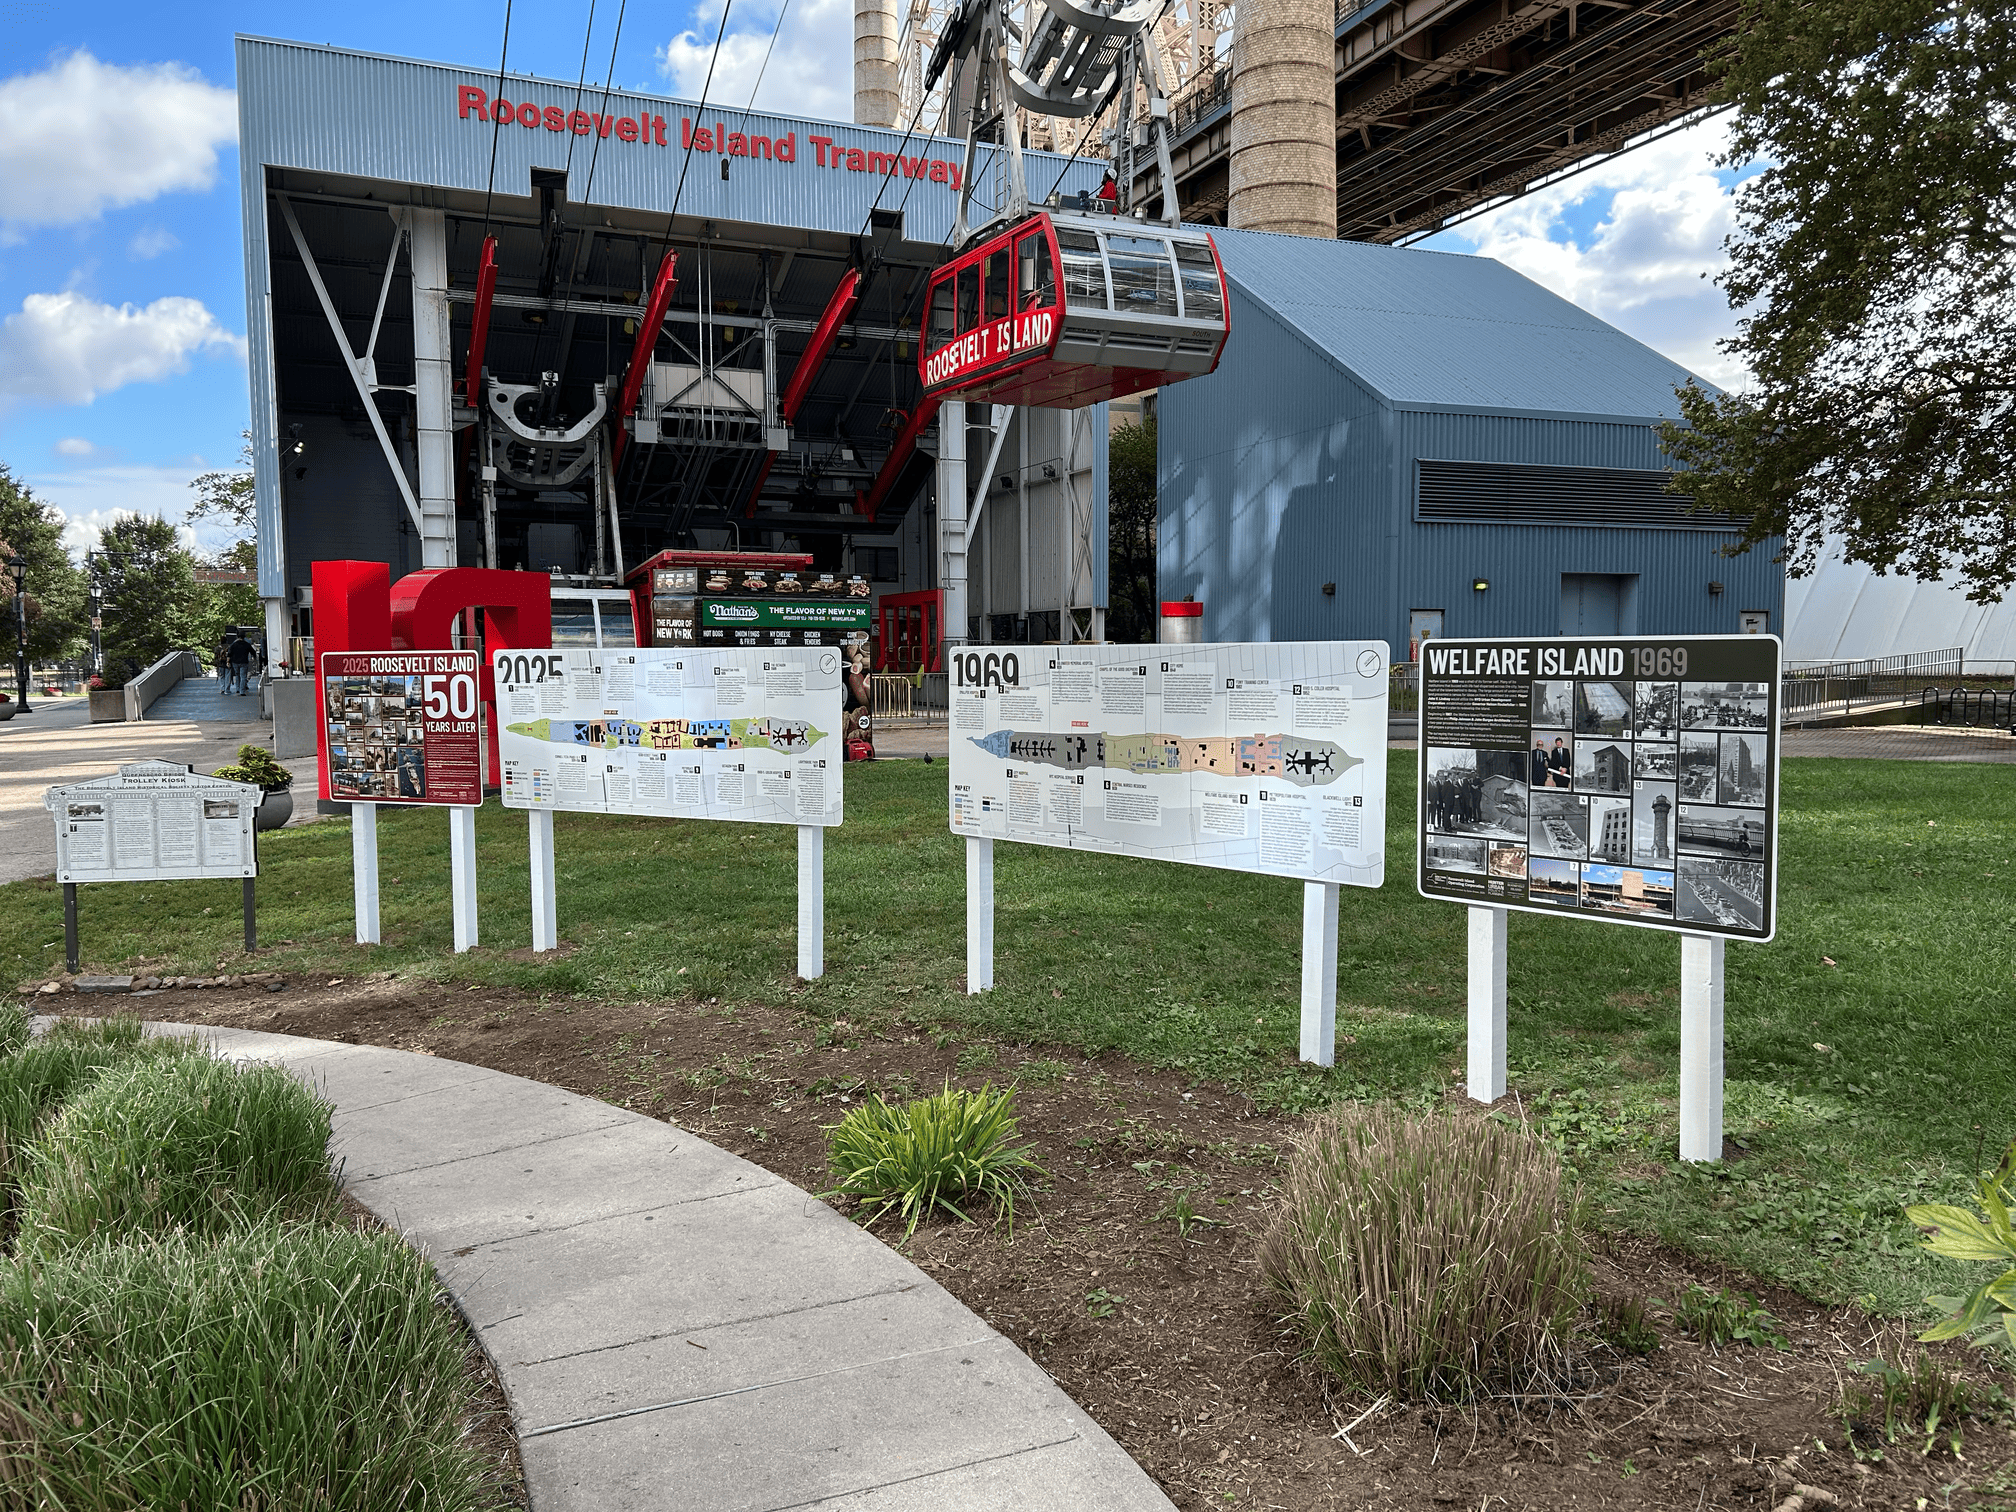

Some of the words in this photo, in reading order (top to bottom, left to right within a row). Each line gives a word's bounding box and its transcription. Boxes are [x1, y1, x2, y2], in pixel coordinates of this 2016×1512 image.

[458, 85, 668, 146] Roosevelt
[682, 117, 796, 163] Island
[809, 135, 963, 191] Tramway
[1191, 330, 1211, 338] SOUTH
[926, 329, 990, 386] ROOSEVELT
[997, 313, 1052, 353] ISLAND
[709, 604, 759, 619] Nathan's
[786, 607, 815, 615] FLAVOR
[656, 619, 665, 627] THE
[666, 619, 684, 627] FLAVOR
[685, 619, 693, 627] OF
[657, 628, 674, 639] NEW
[804, 638, 821, 646] TENDERS
[343, 658, 369, 673] 2025
[370, 656, 431, 673] ROOSEVELT
[434, 656, 475, 673] ISLAND
[498, 655, 563, 683] 2025
[1428, 648, 1530, 675] WELFARE
[1537, 647, 1624, 676] ISLAND
[1631, 646, 1688, 676] 1969
[953, 652, 1019, 687] 1969
[423, 674, 476, 720] 50
[425, 721, 451, 733] YEARS
[451, 721, 477, 733] LATER
